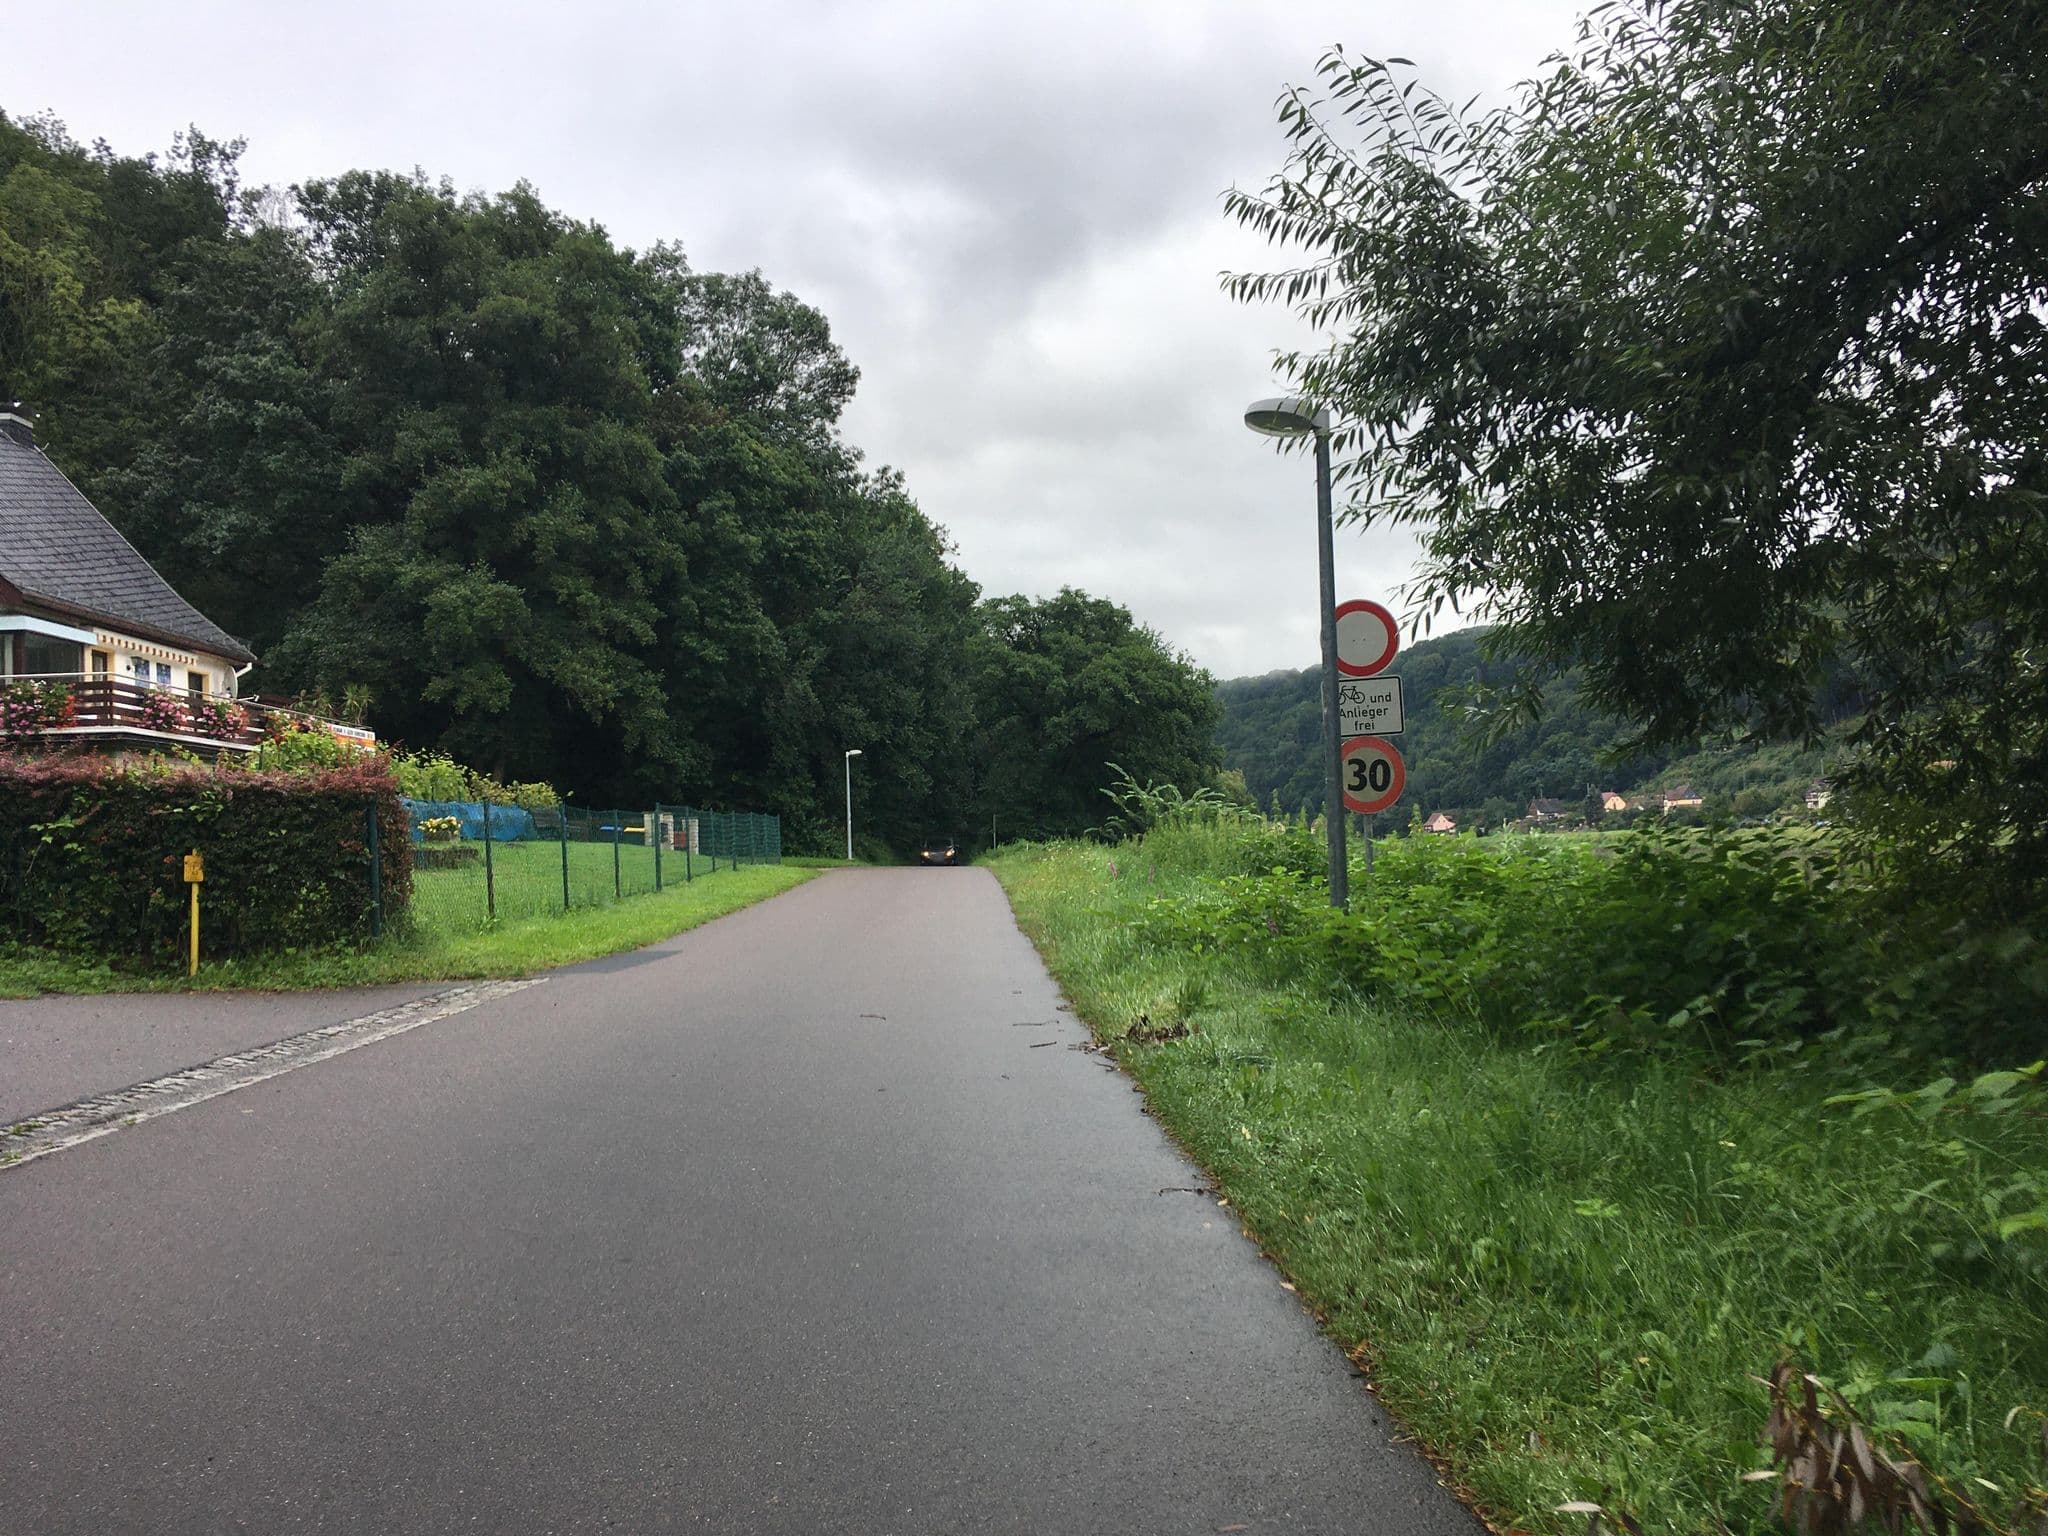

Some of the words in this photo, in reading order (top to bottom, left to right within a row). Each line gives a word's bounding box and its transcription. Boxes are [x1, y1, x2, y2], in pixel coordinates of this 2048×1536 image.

[1370, 692, 1392, 703] und
[1340, 706, 1389, 719] Anlieger
[1354, 720, 1375, 731] frei
[1347, 758, 1391, 792] 30
